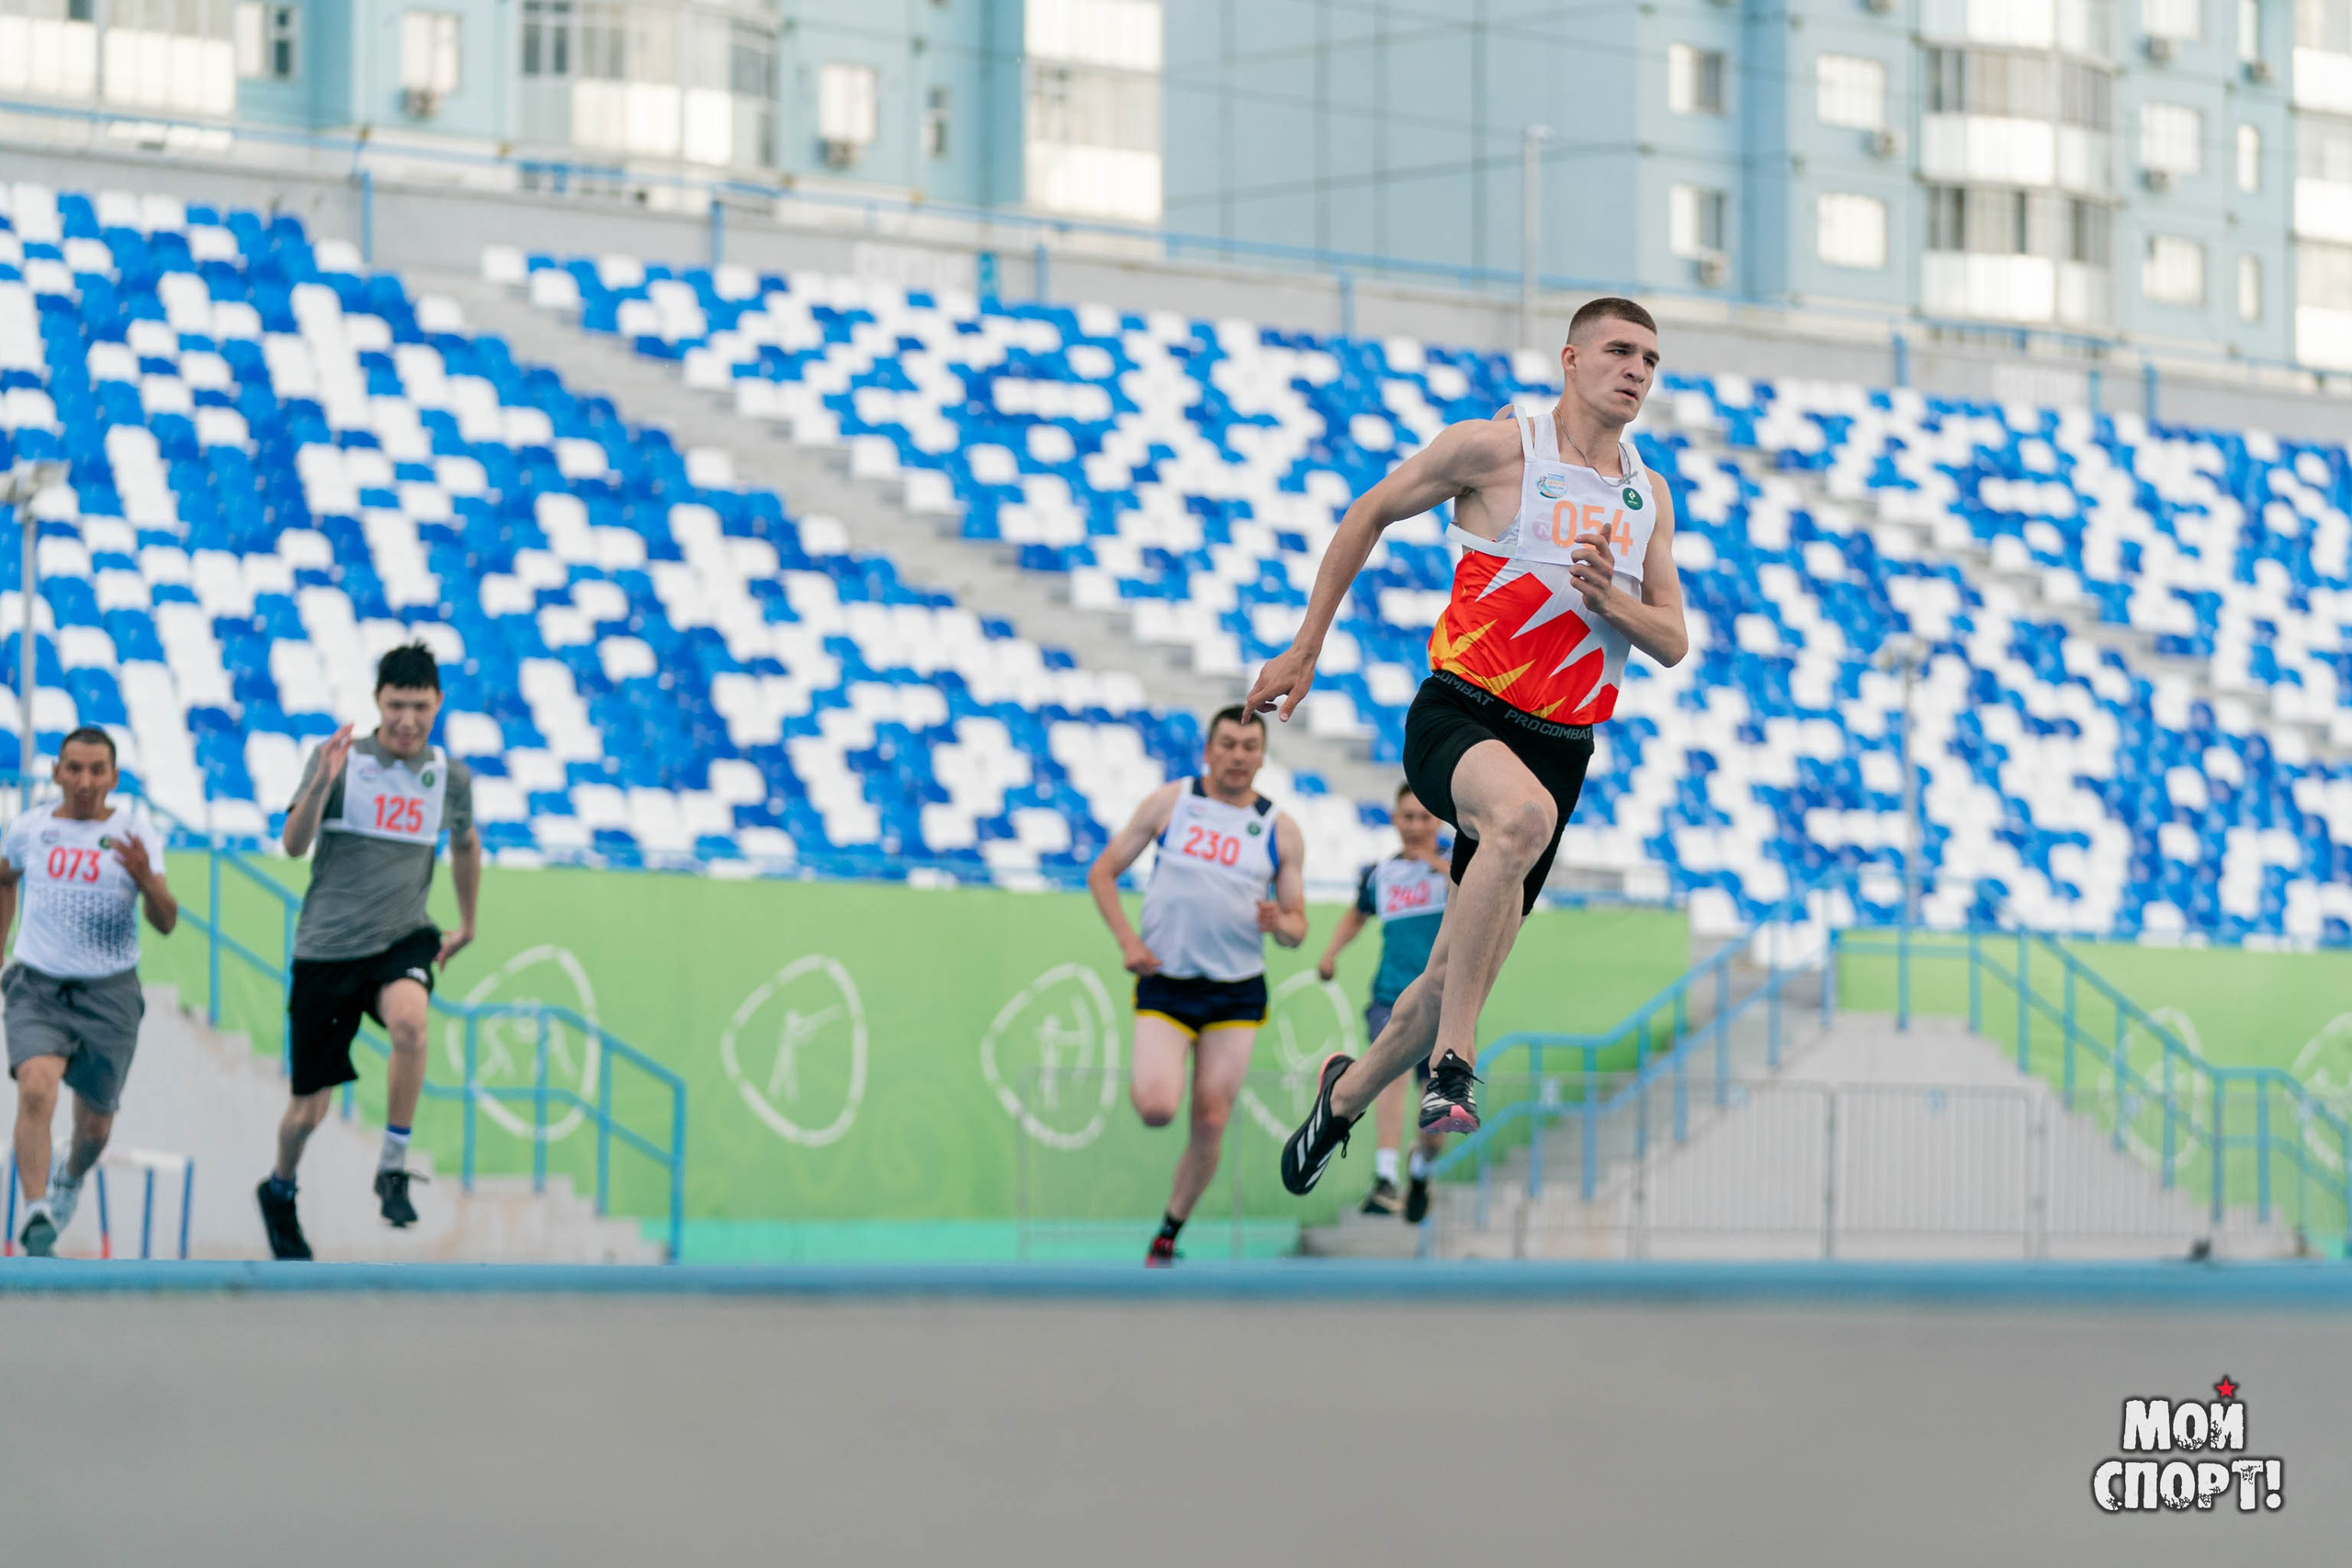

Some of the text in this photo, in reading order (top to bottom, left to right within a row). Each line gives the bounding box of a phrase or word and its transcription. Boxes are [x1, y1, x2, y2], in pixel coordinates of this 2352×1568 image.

[1552, 501, 1634, 558] 054
[374, 794, 424, 834] 125
[47, 846, 101, 884] 073
[1183, 825, 1240, 867] 230
